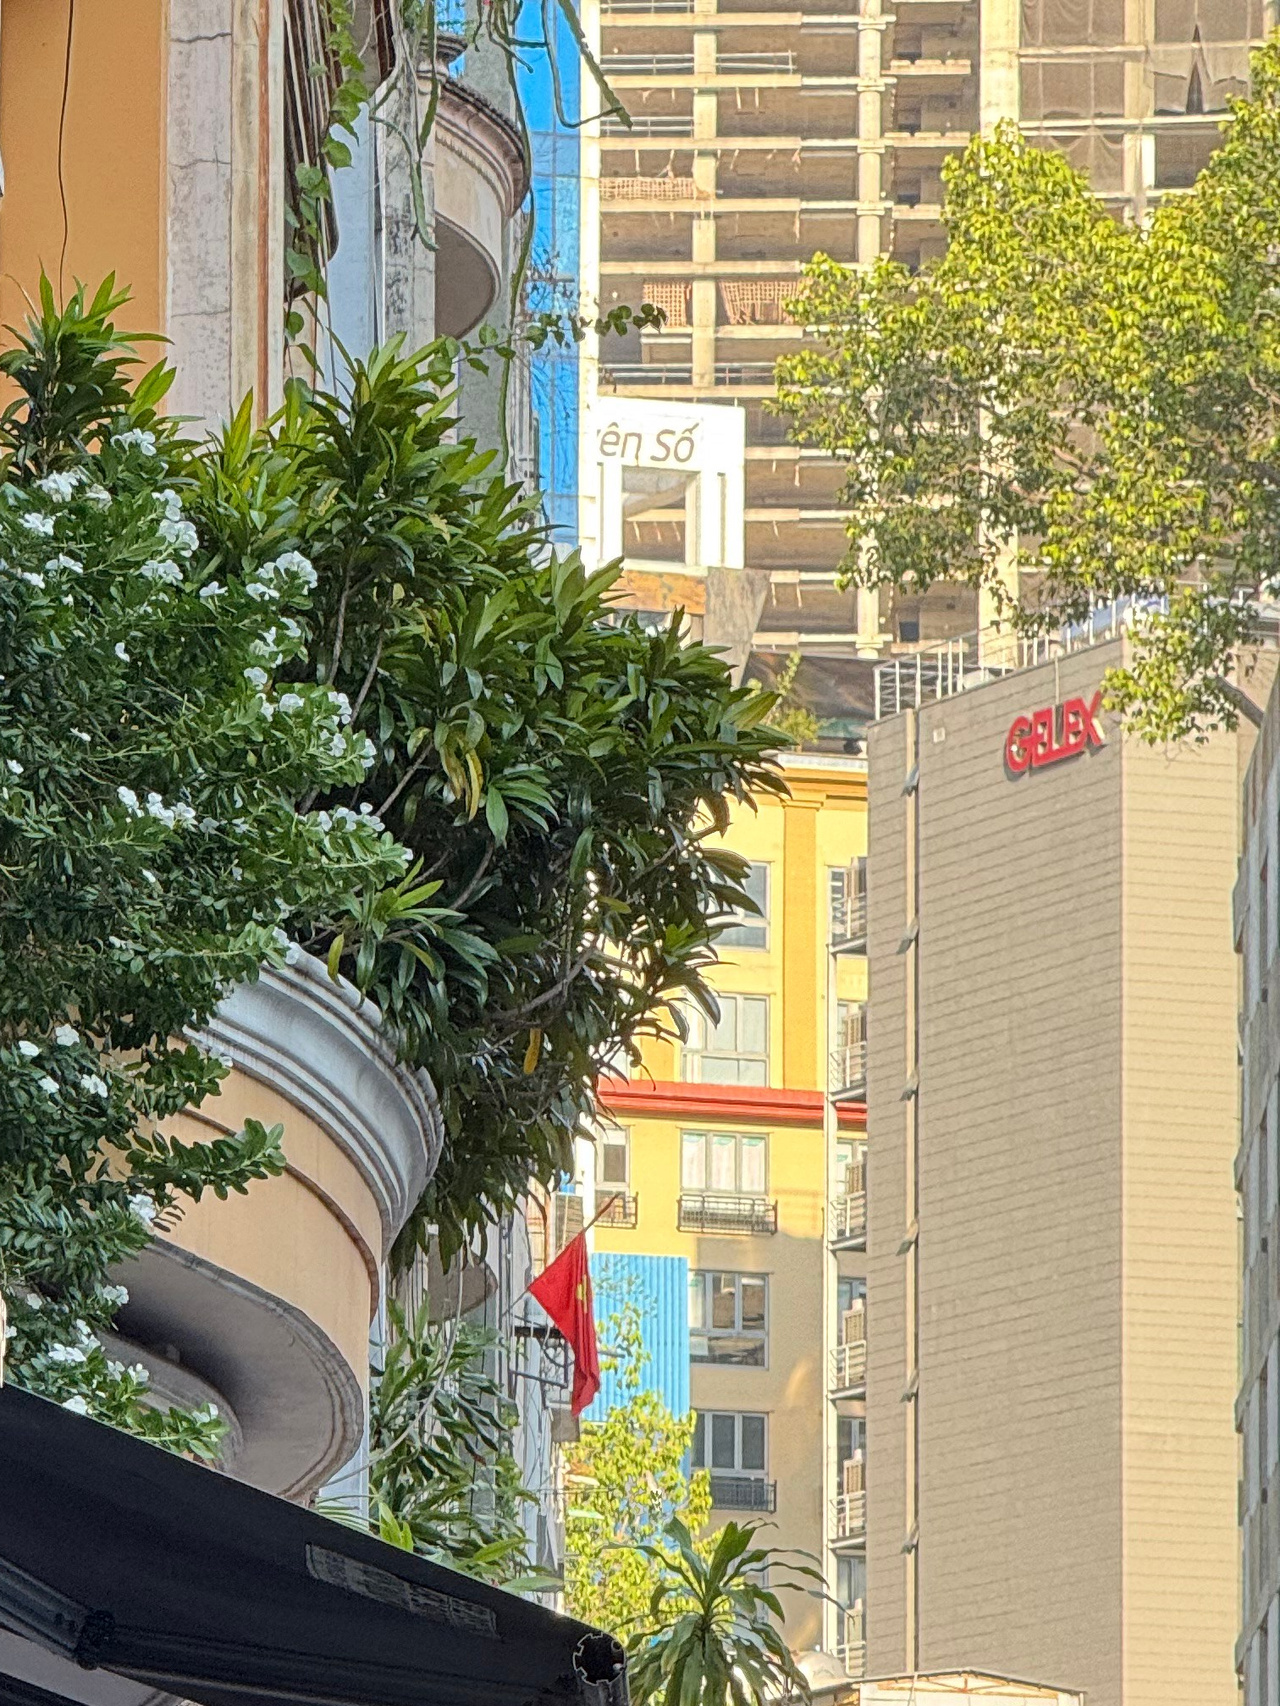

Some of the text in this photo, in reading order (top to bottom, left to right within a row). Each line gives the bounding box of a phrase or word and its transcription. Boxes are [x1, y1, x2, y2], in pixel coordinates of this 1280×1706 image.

[596, 421, 700, 463] ên Số
[1006, 689, 1103, 772] GELEX
